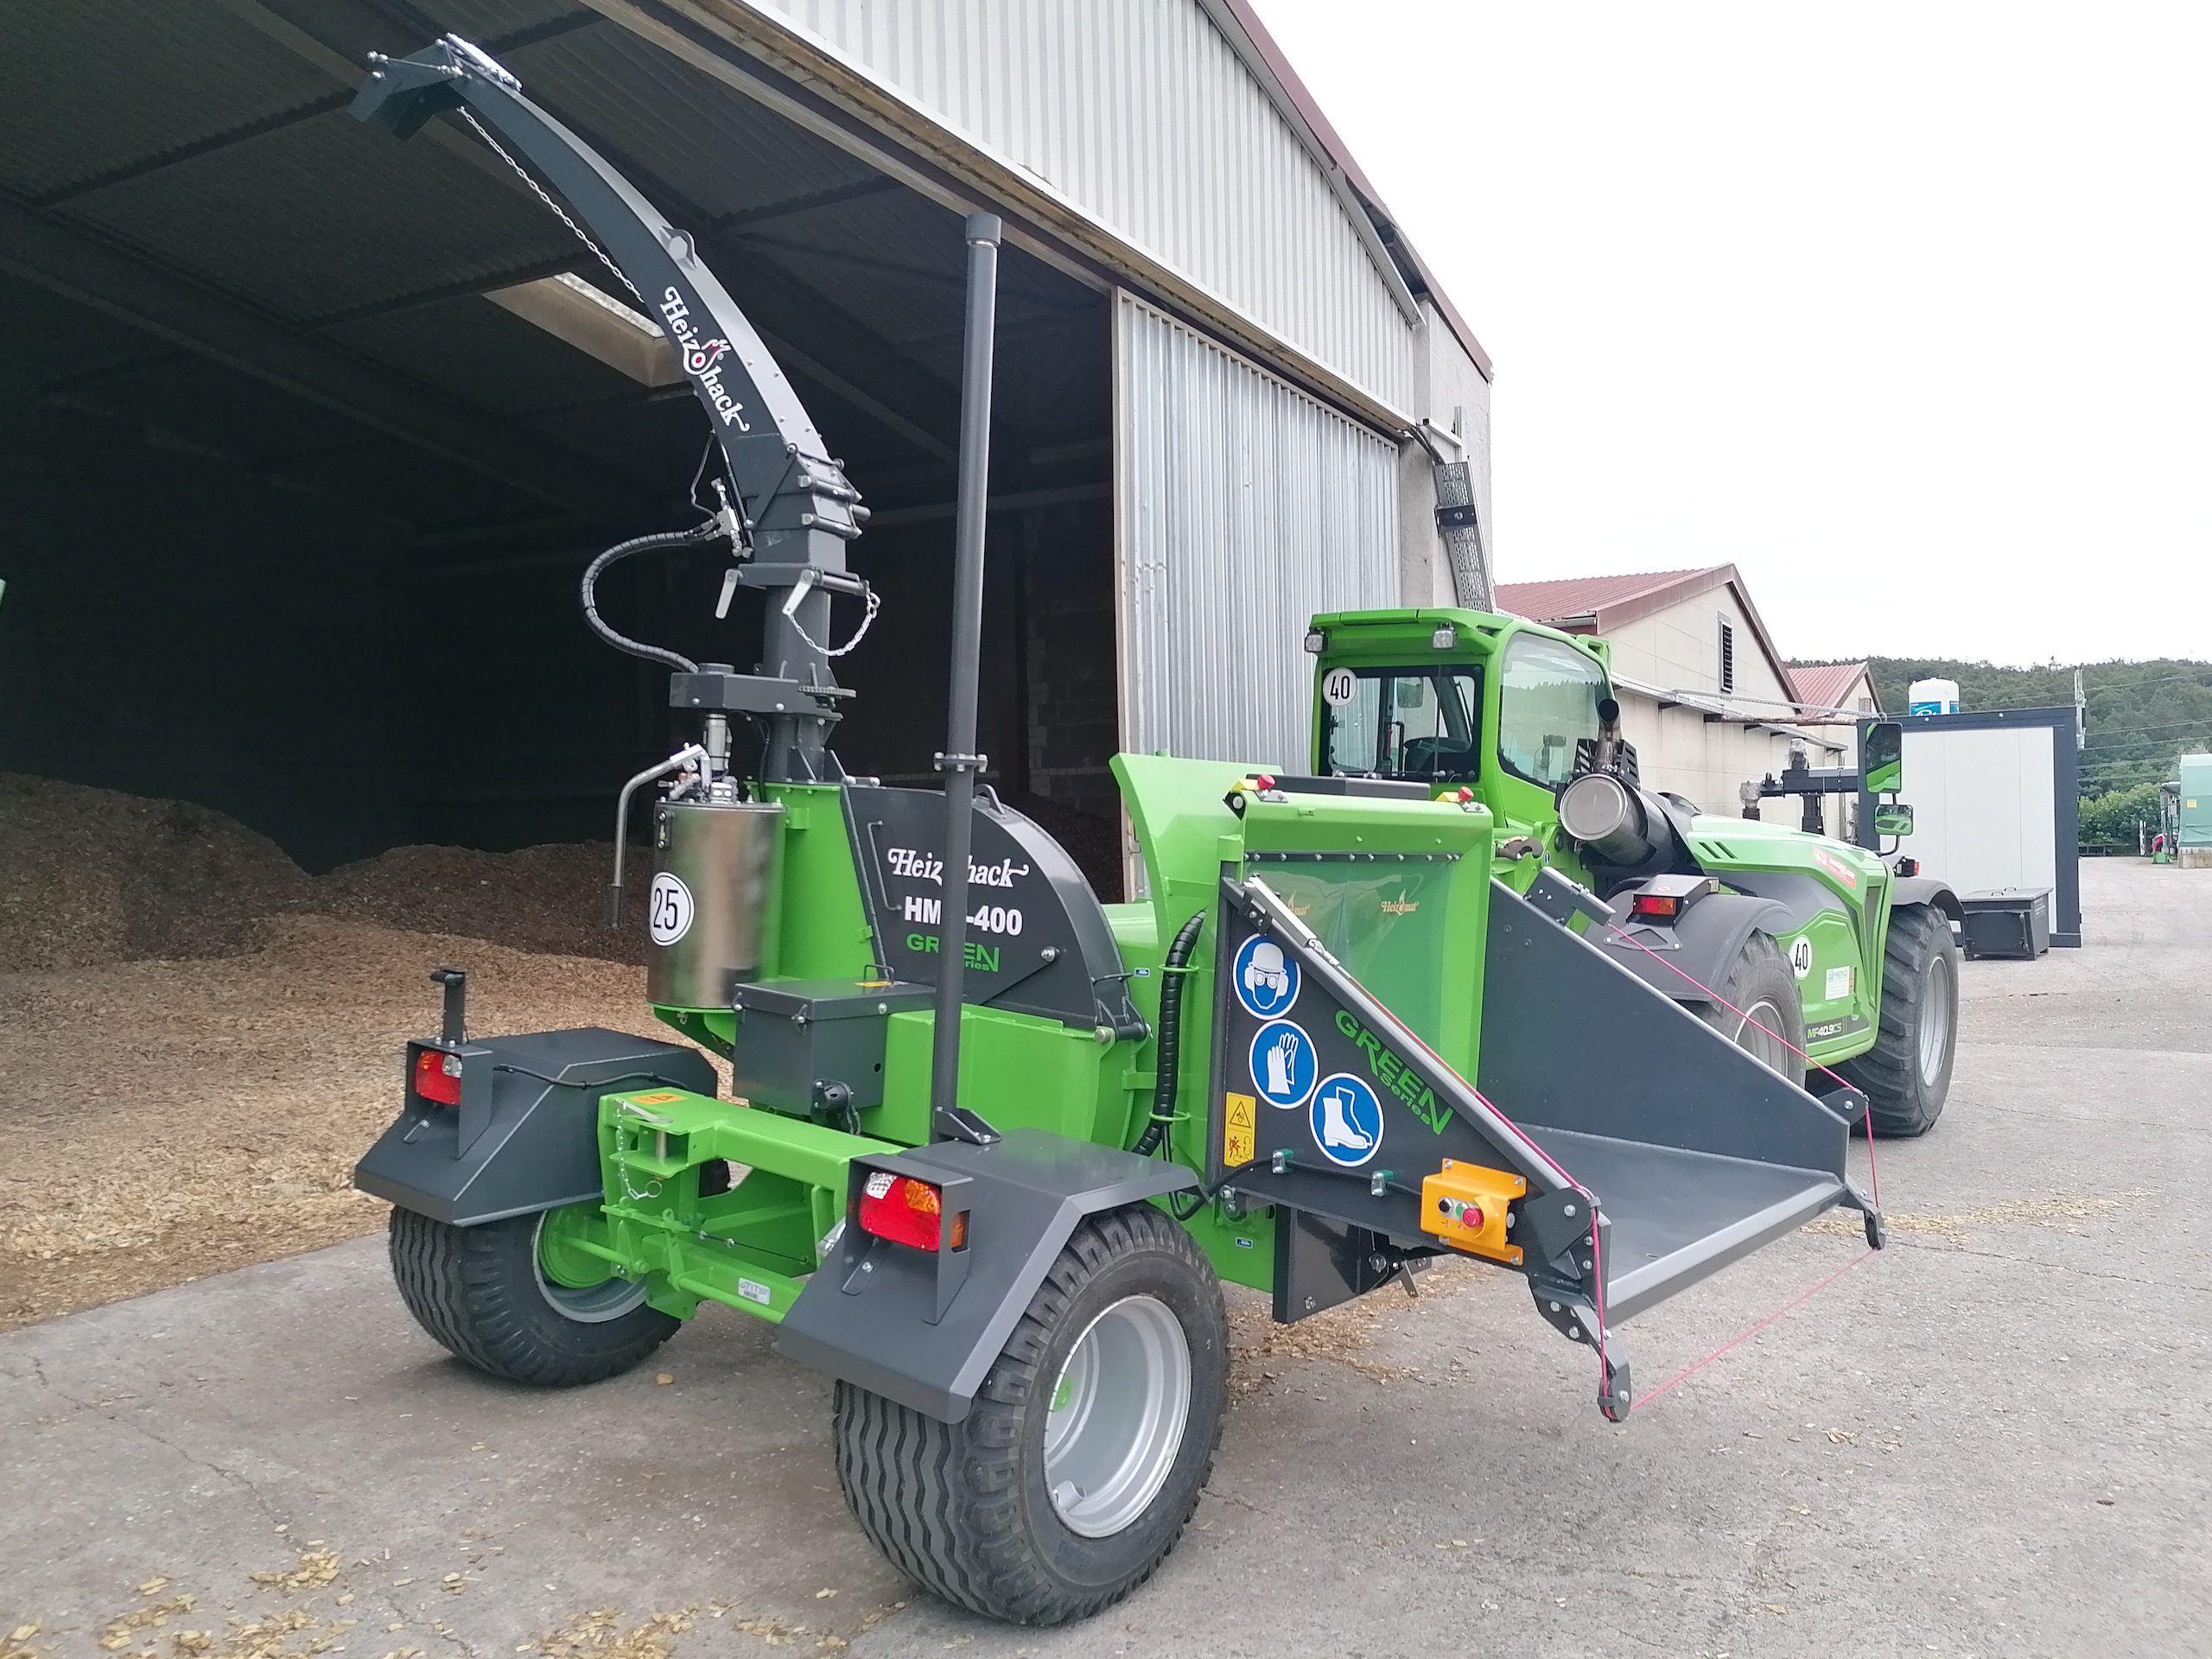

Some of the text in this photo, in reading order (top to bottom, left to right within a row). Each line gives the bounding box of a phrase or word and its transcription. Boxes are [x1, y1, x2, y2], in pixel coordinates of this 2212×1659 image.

[1330, 676, 1351, 700] 40
[887, 848, 1029, 887] Heizhack
[654, 887, 678, 930] 25
[905, 896, 1023, 936] HM-400
[906, 933, 1000, 972] GREN
[1795, 943, 1808, 971] 40
[1336, 1010, 1453, 1135] GREEN
